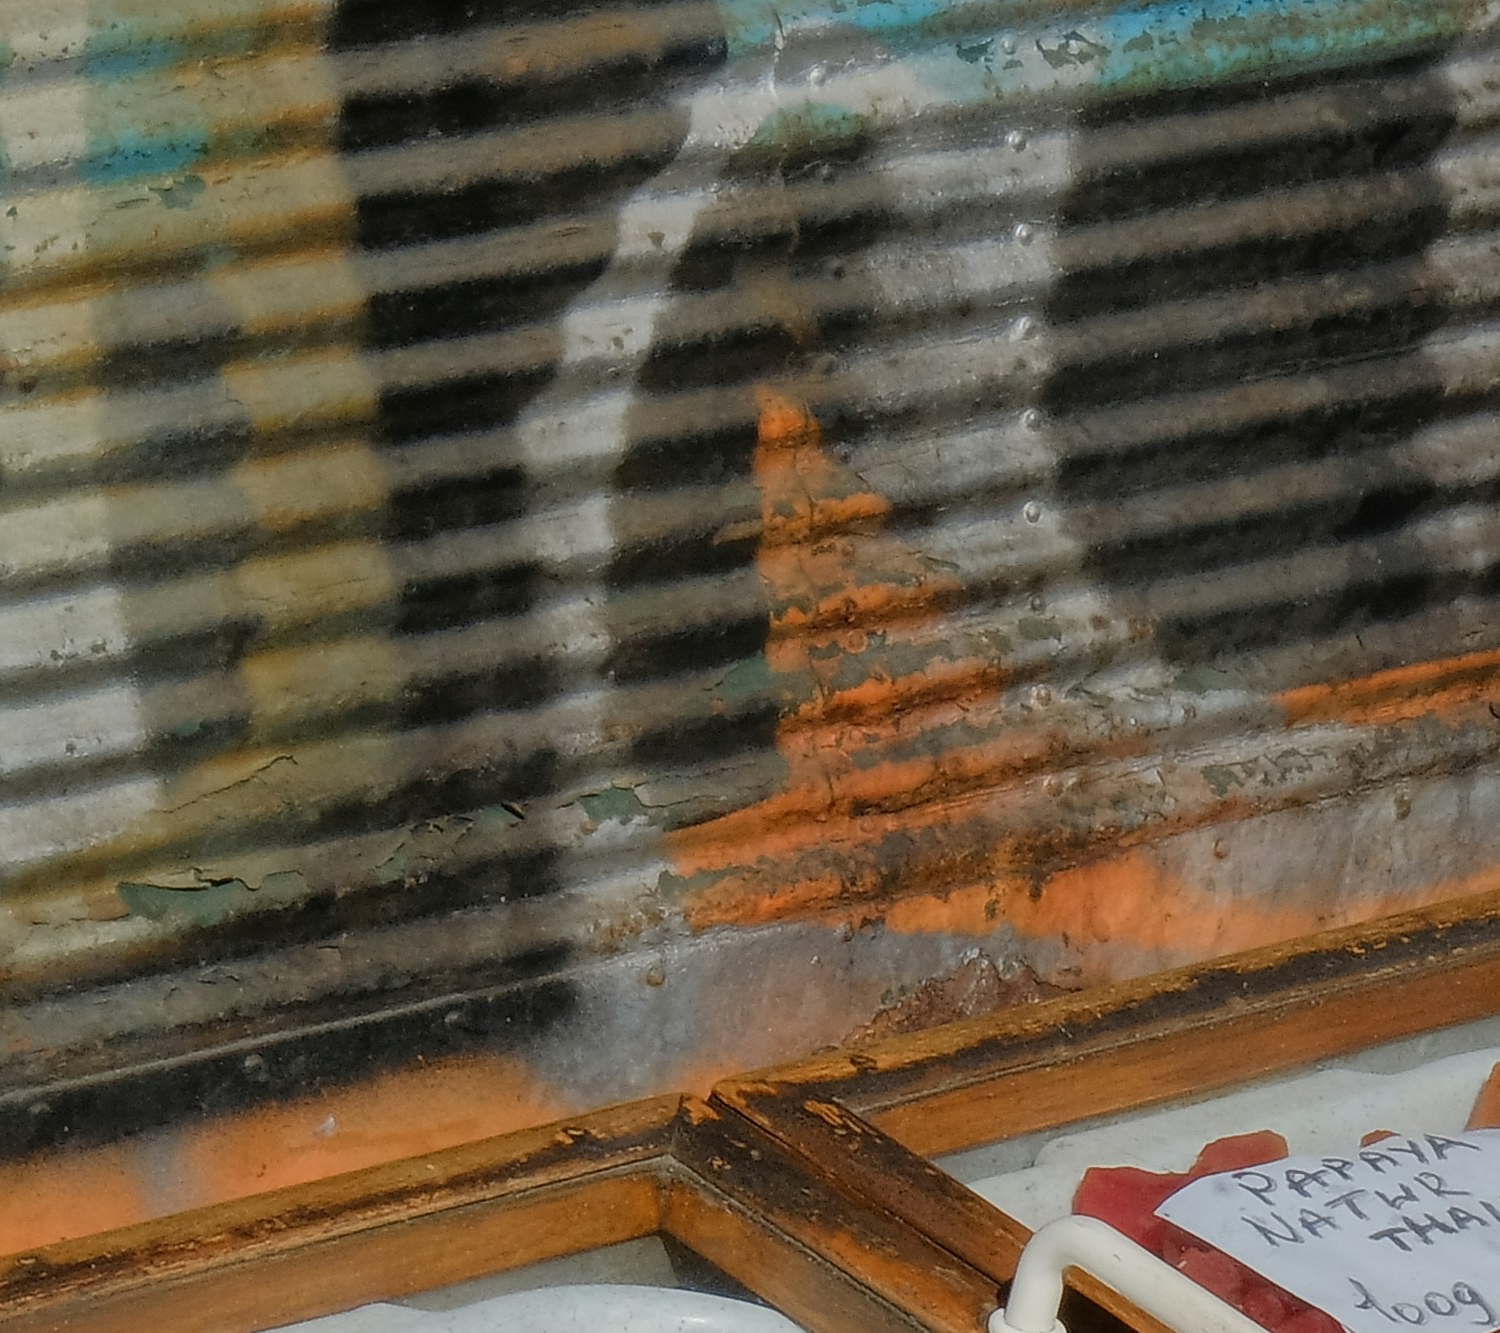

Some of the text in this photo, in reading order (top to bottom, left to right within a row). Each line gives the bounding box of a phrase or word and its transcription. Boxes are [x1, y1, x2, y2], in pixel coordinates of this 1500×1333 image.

[1230, 1130, 1483, 1207] PAPAYA
[1241, 1172, 1471, 1249] NATUR
[1347, 1276, 1500, 1328] 100g
